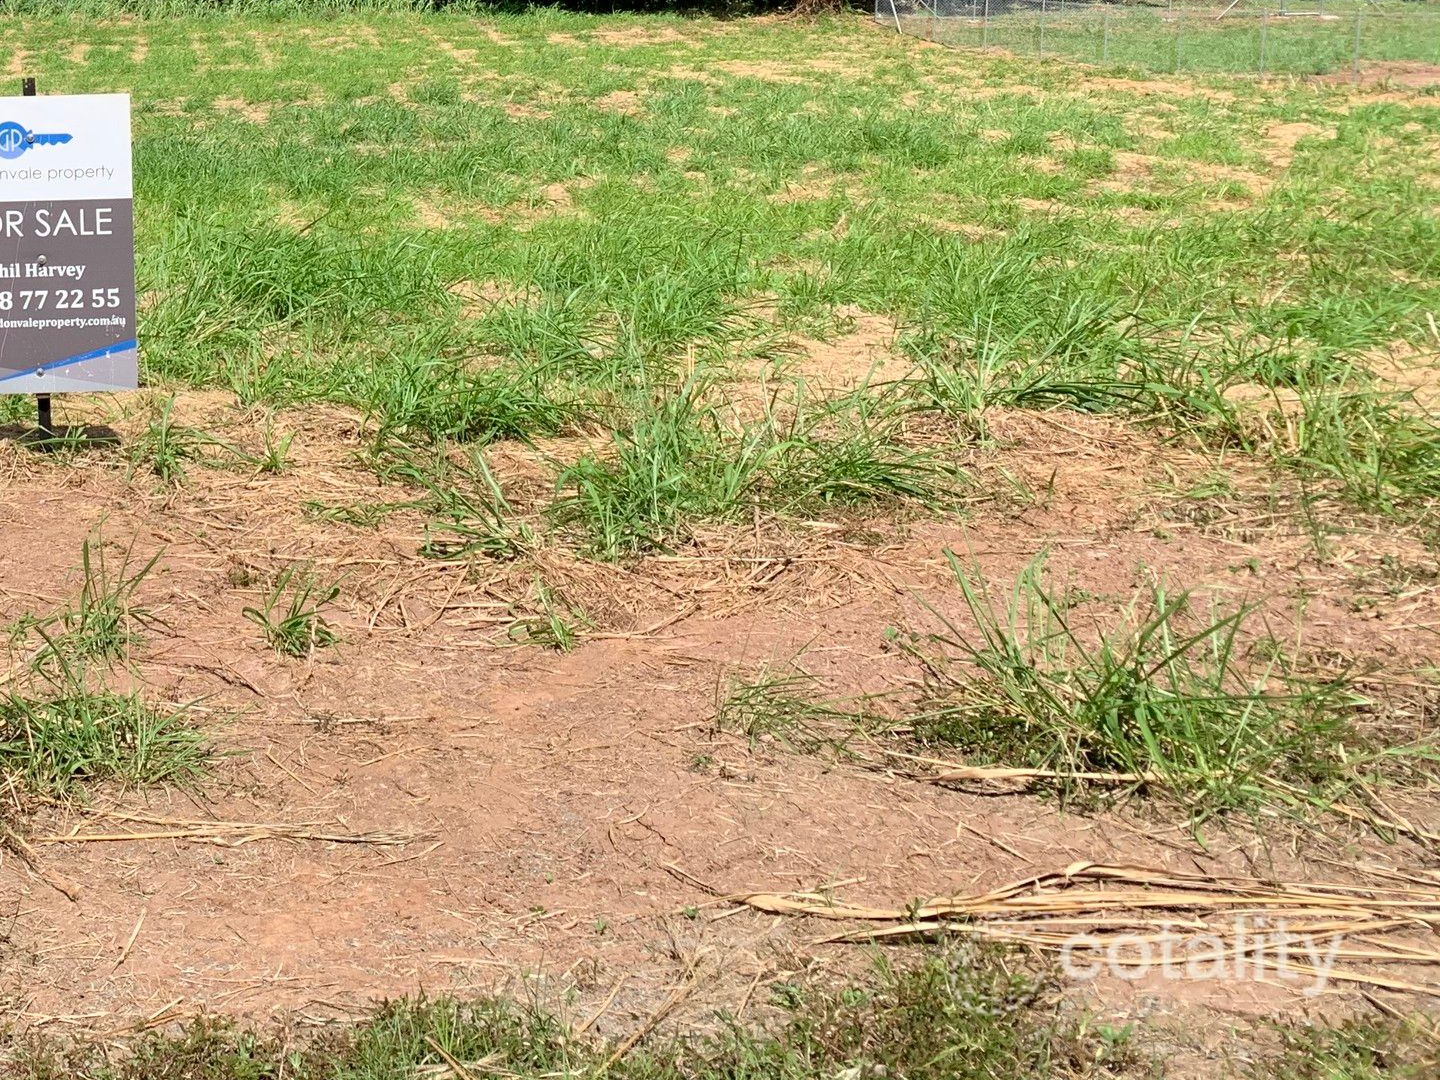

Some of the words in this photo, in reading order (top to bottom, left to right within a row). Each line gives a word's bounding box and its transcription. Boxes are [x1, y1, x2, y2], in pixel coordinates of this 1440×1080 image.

[47, 165, 115, 181] property
[34, 208, 113, 237] SALE
[24, 262, 86, 281] Harvey
[19, 290, 49, 310] 77
[55, 289, 84, 309] 22
[91, 287, 121, 308] 55
